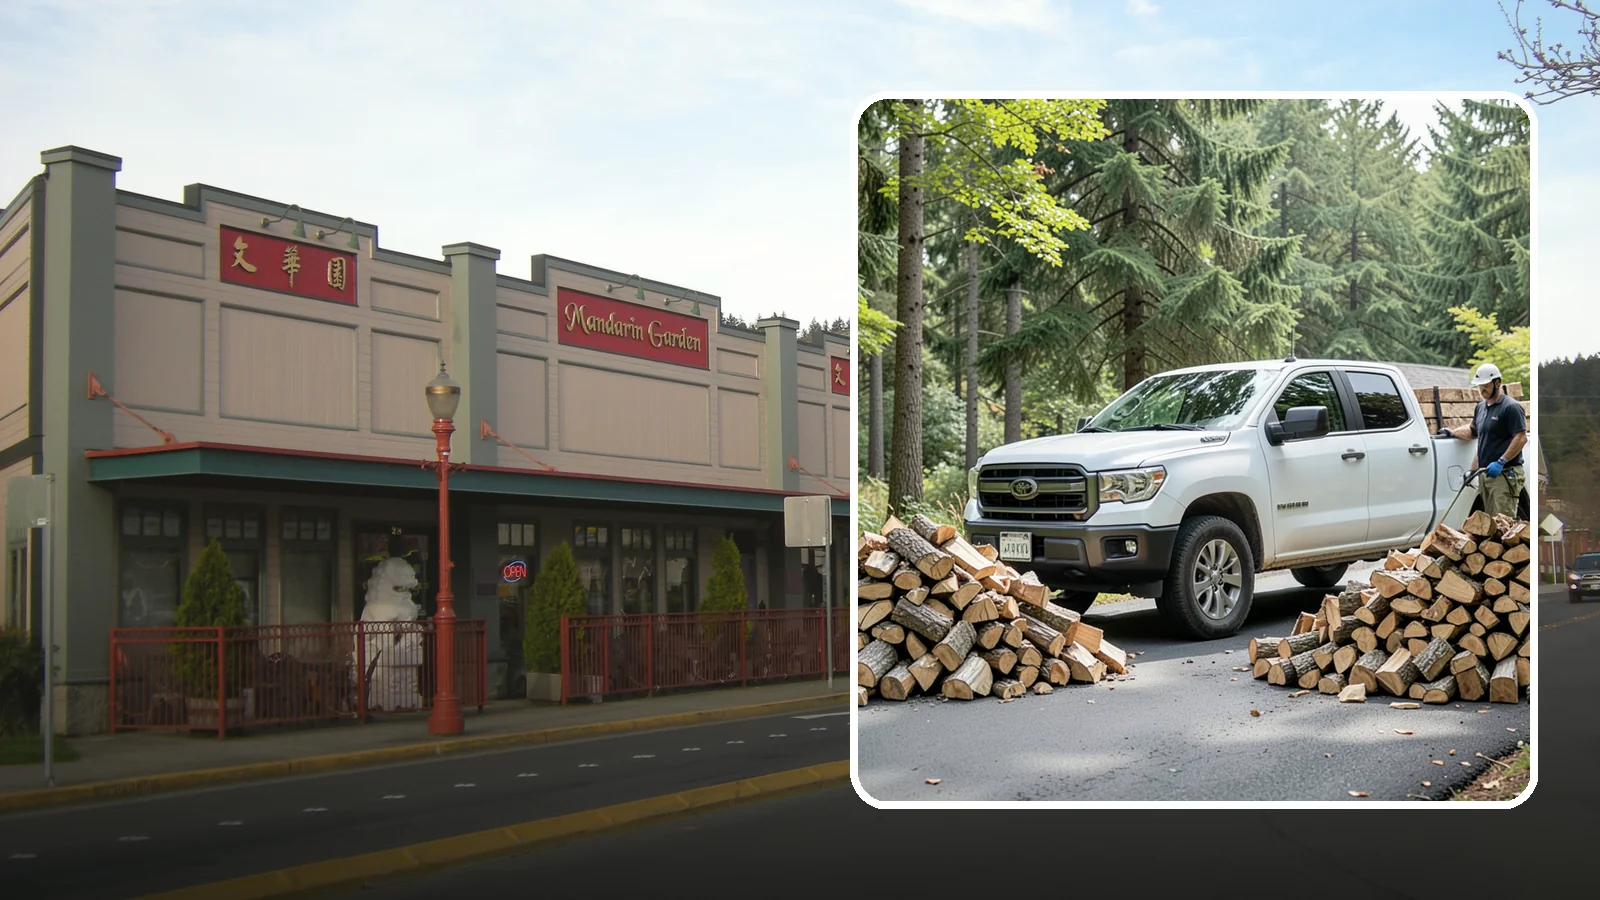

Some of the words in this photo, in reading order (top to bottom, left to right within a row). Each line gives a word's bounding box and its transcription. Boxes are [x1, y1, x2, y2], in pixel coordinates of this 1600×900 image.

[231, 235, 346, 291] 文華園
[564, 302, 644, 341] Mandarin
[648, 319, 701, 352] Garden
[503, 565, 527, 578] OPEN
